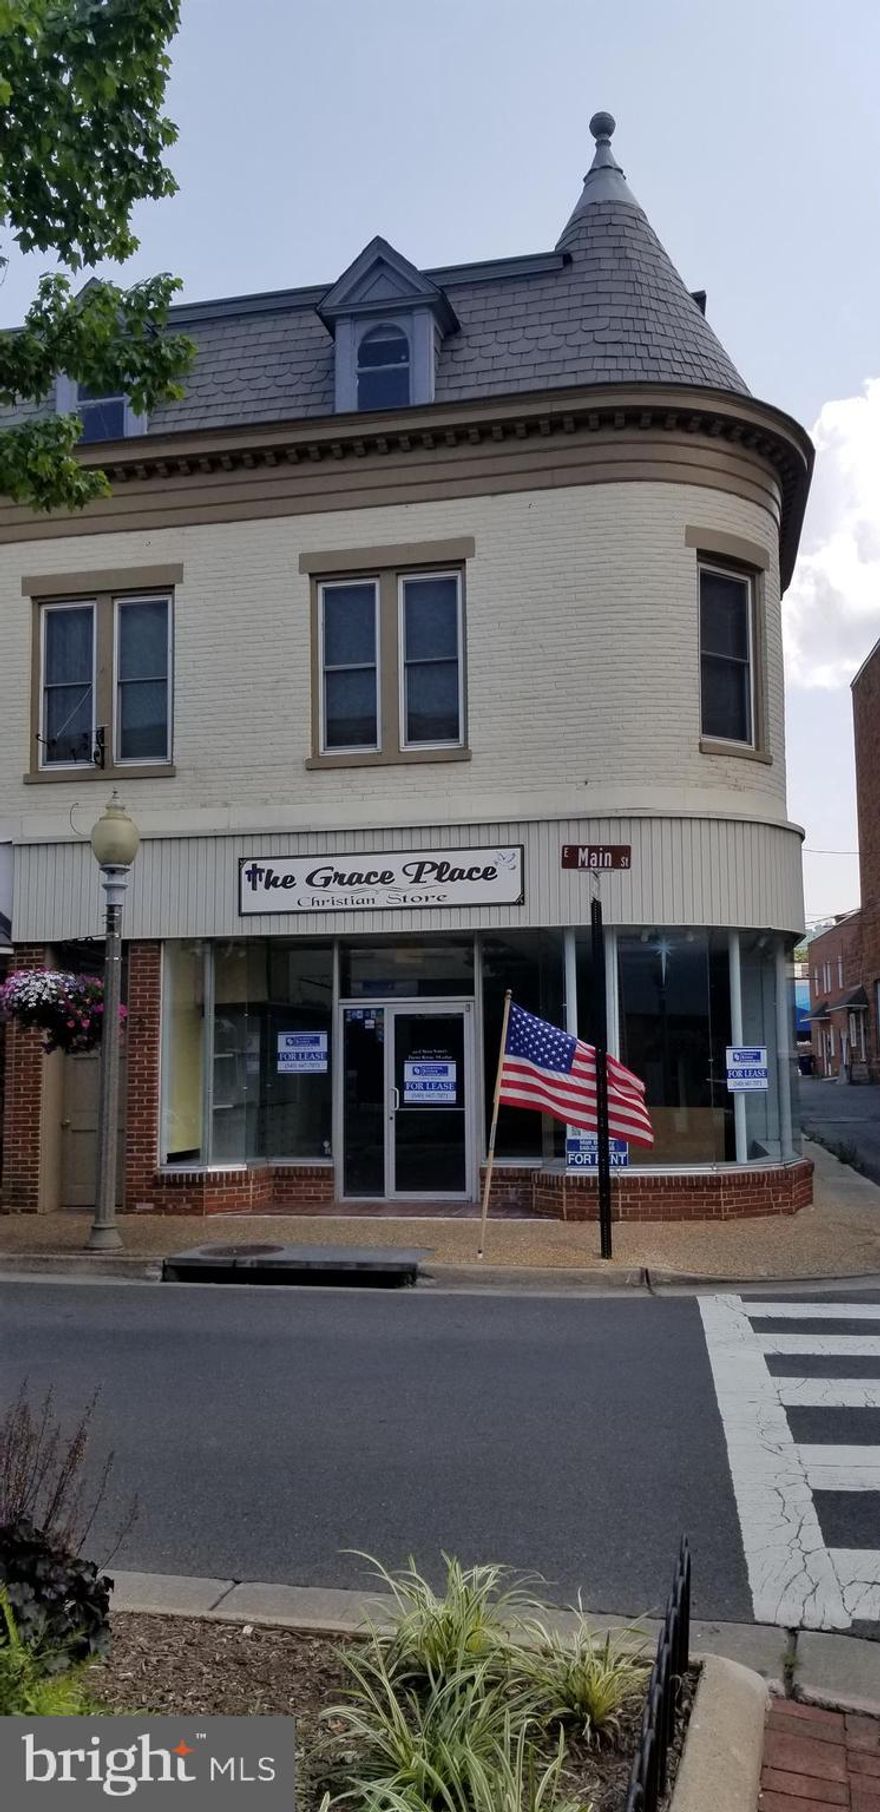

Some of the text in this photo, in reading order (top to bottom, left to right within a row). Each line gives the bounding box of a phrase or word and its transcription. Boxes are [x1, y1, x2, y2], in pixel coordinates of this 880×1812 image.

[564, 847, 629, 867] E Main St
[305, 865, 395, 888] Grace
[402, 860, 498, 884] Place
[297, 892, 447, 907] Christian Store
[279, 1053, 296, 1061] FOR
[727, 1069, 767, 1078] FOR LEASE
[406, 1082, 455, 1090] FOR LEASE
[568, 1153, 591, 1164] FOR
